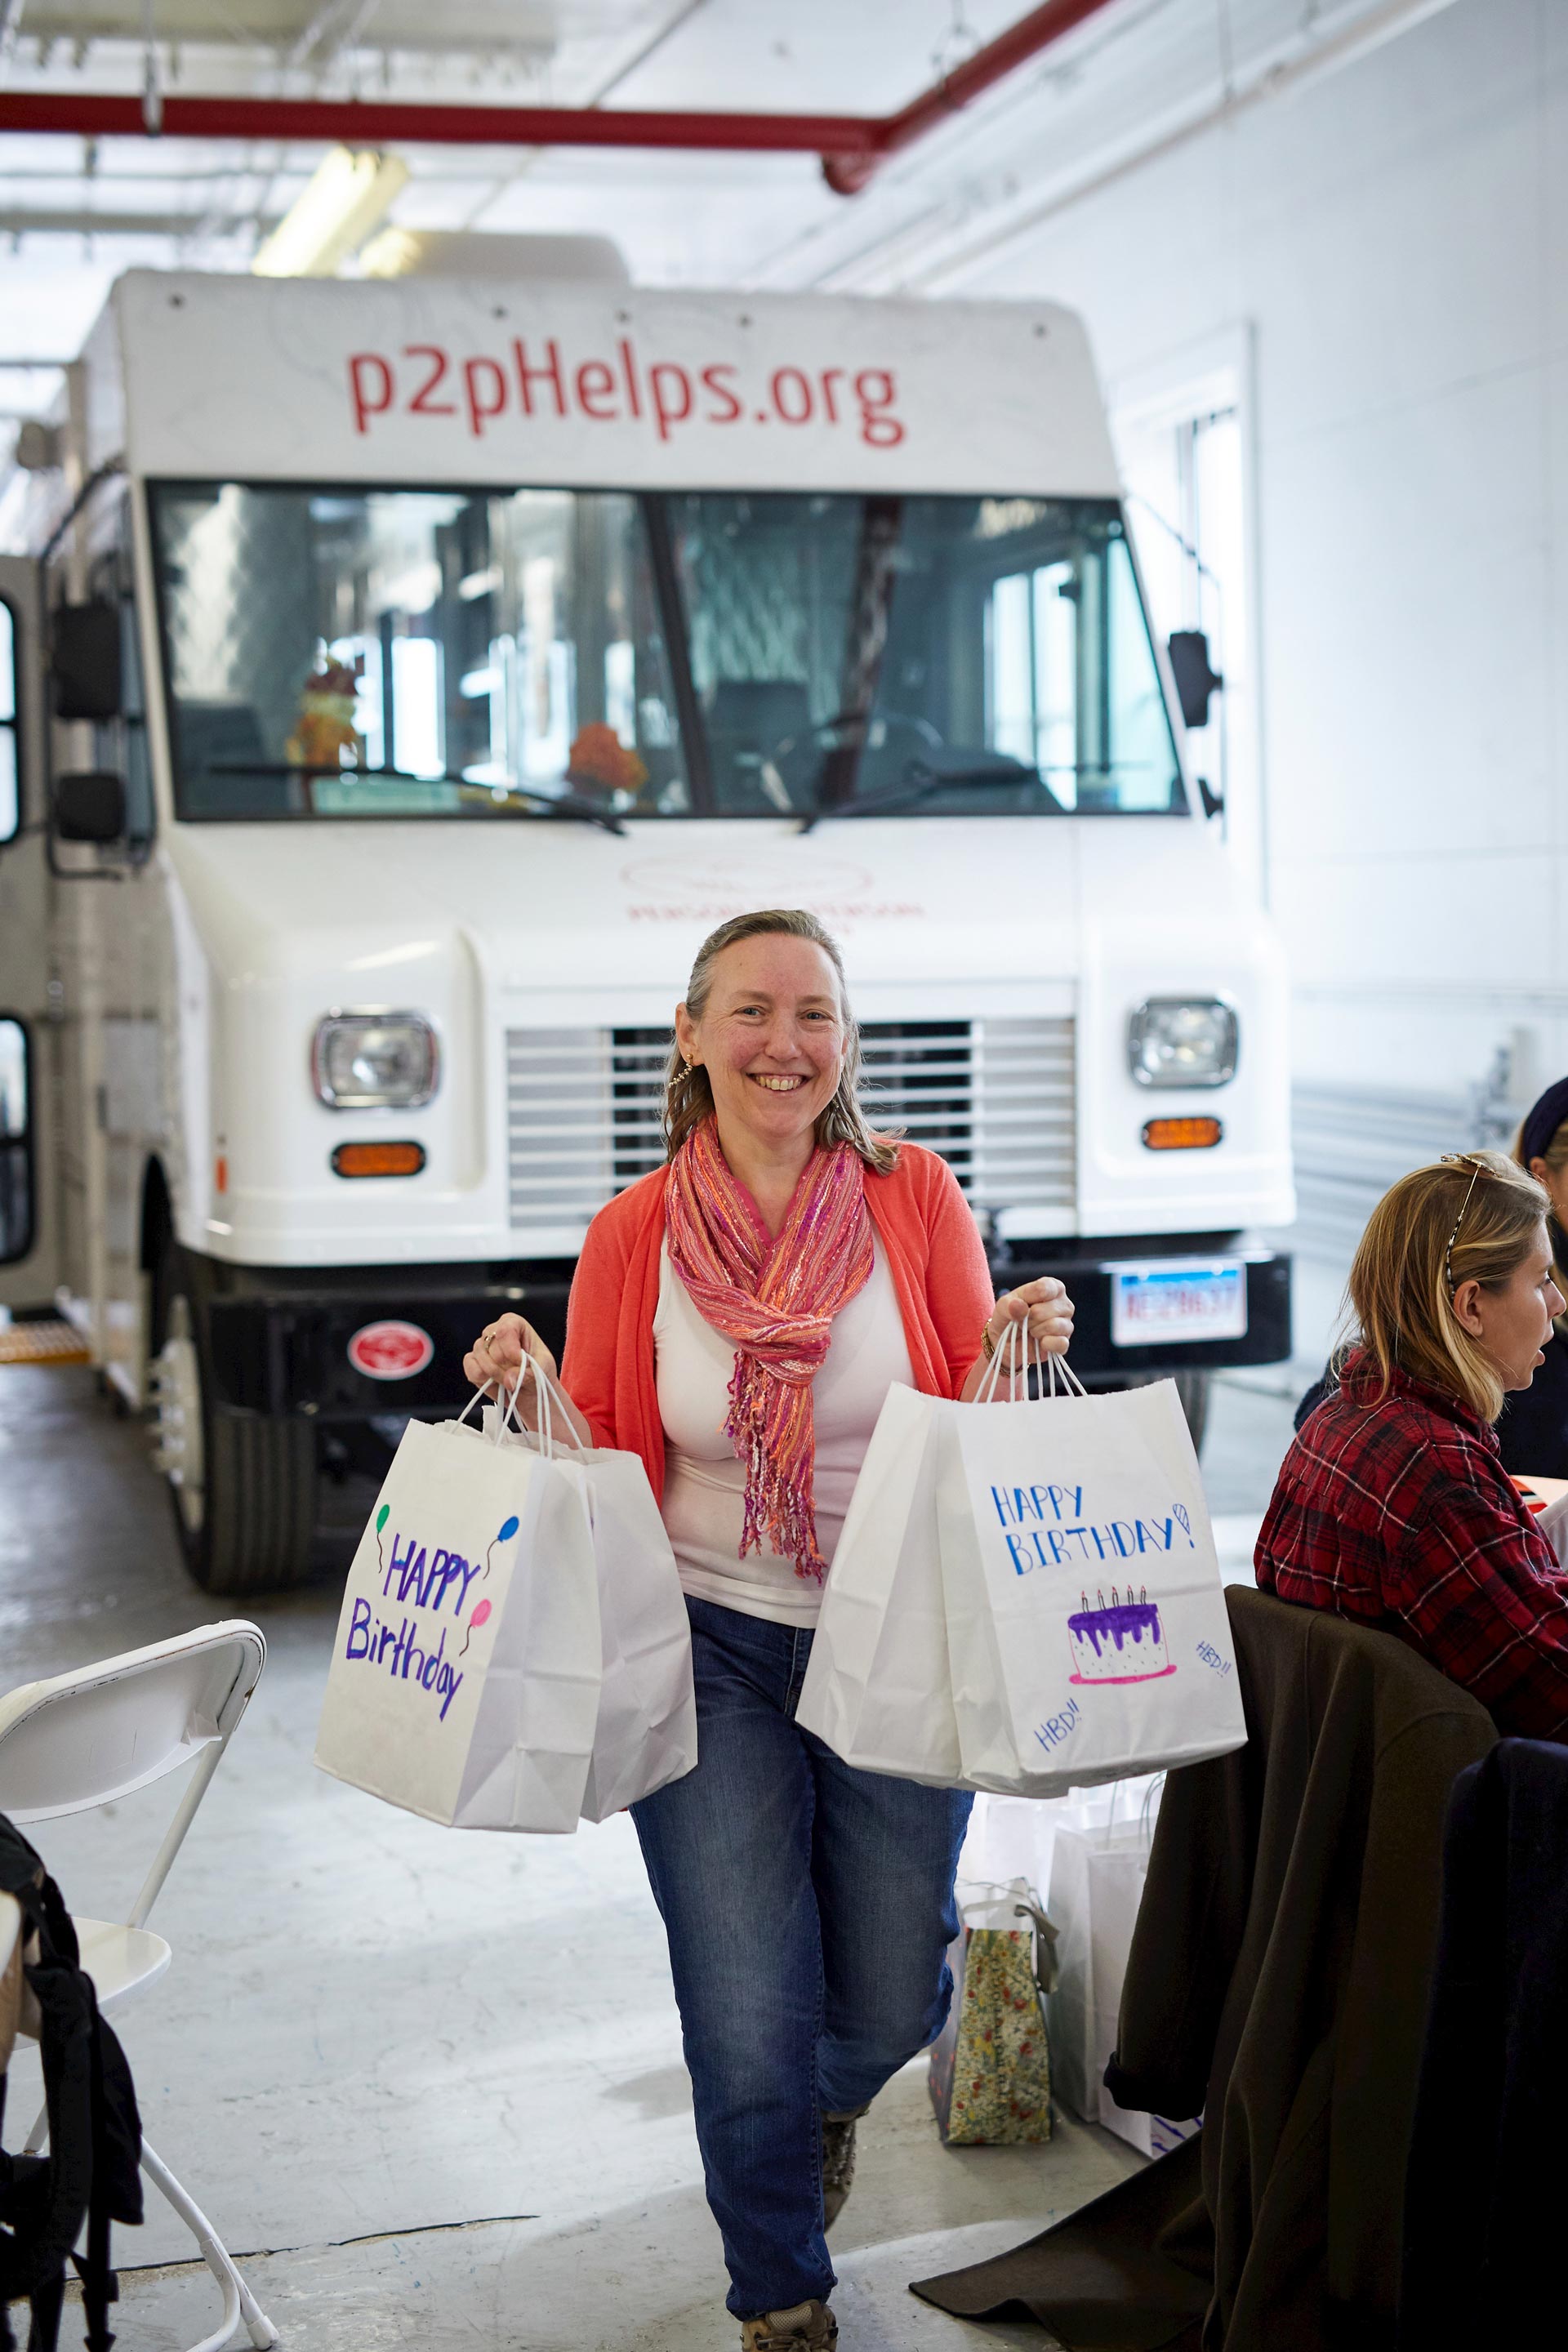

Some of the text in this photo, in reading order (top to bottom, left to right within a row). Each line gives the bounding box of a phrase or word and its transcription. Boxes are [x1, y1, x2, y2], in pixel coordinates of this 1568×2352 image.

[349, 336, 906, 447] p2pHelps.org
[991, 1486, 1082, 1527] HAPPY
[383, 1533, 481, 1616] HAPPY
[346, 1597, 463, 1722] Birthday
[1196, 1640, 1232, 1677] HBD!!
[1034, 1698, 1082, 1753] HBD!!
